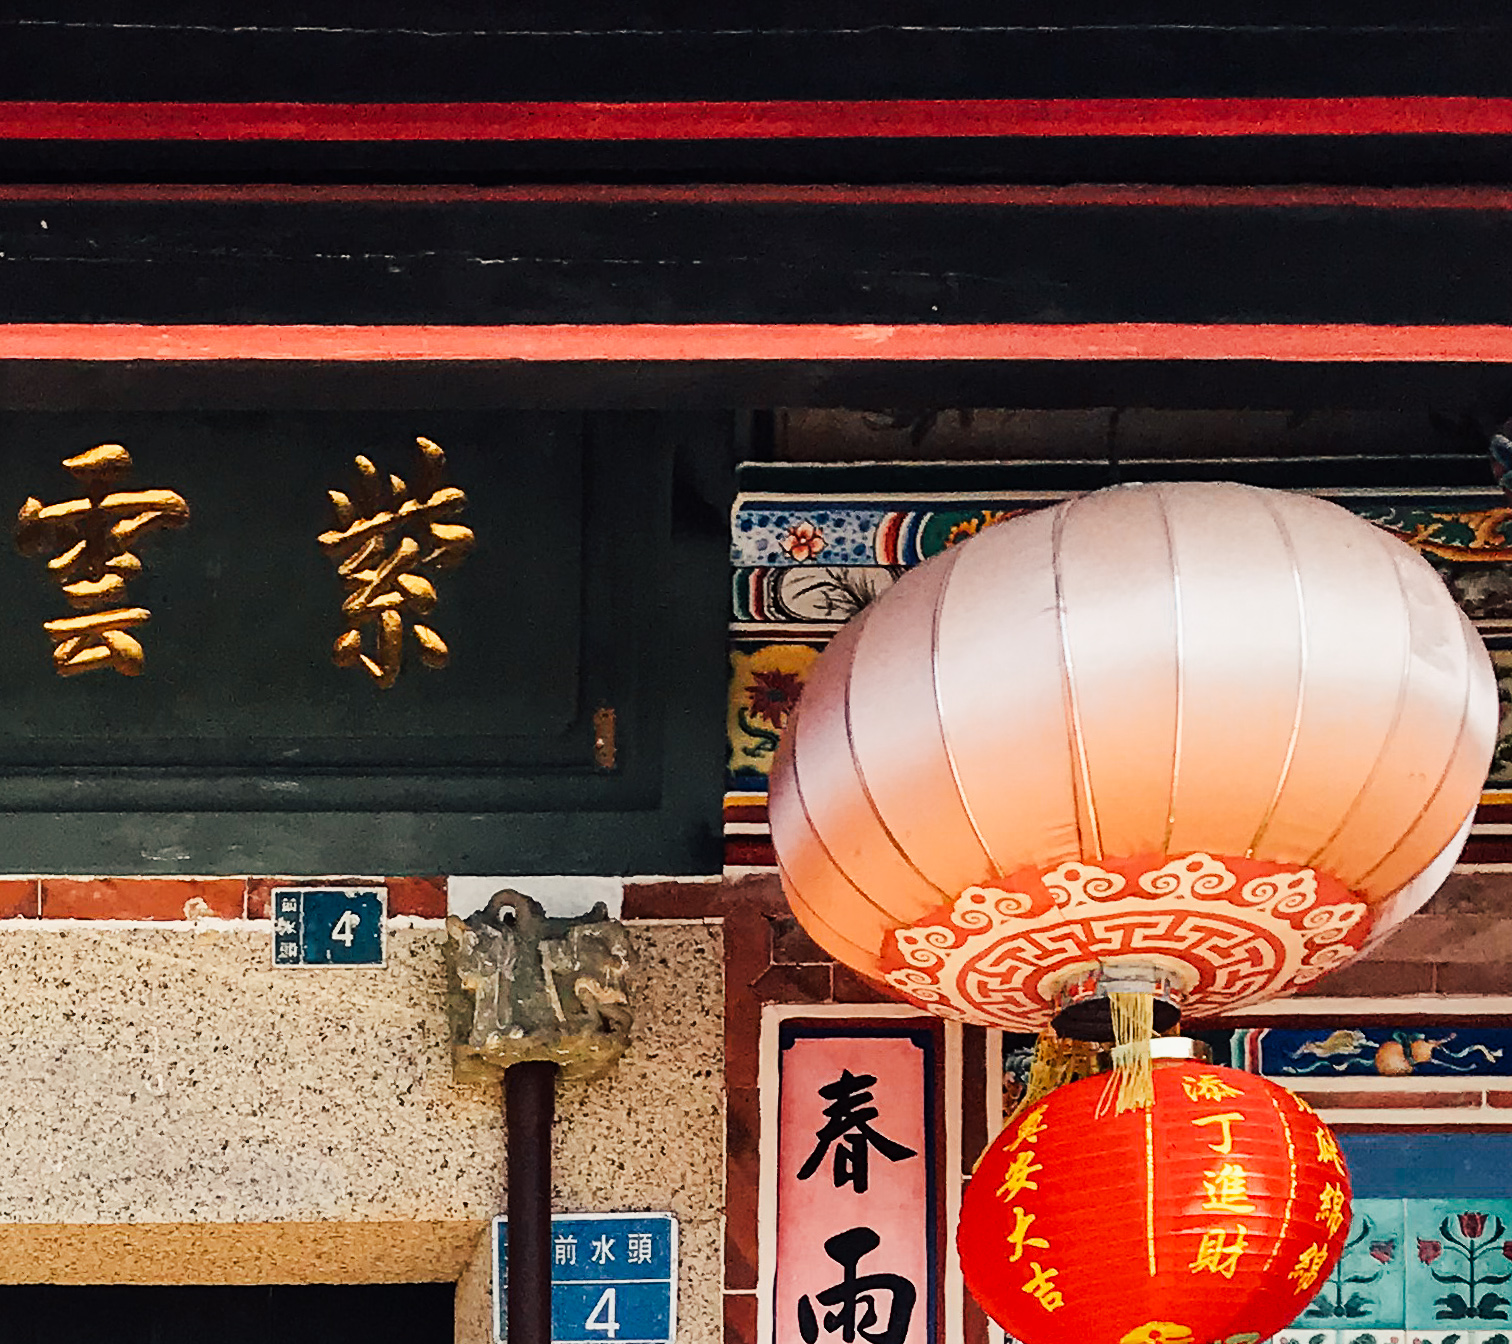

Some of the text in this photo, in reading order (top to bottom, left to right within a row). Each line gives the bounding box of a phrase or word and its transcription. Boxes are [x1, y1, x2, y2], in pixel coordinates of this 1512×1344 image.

[331, 910, 354, 947] 4
[1182, 1074, 1256, 1279] 添丁進財
[554, 1233, 653, 1264] 前水頭
[585, 1288, 620, 1338] 4
